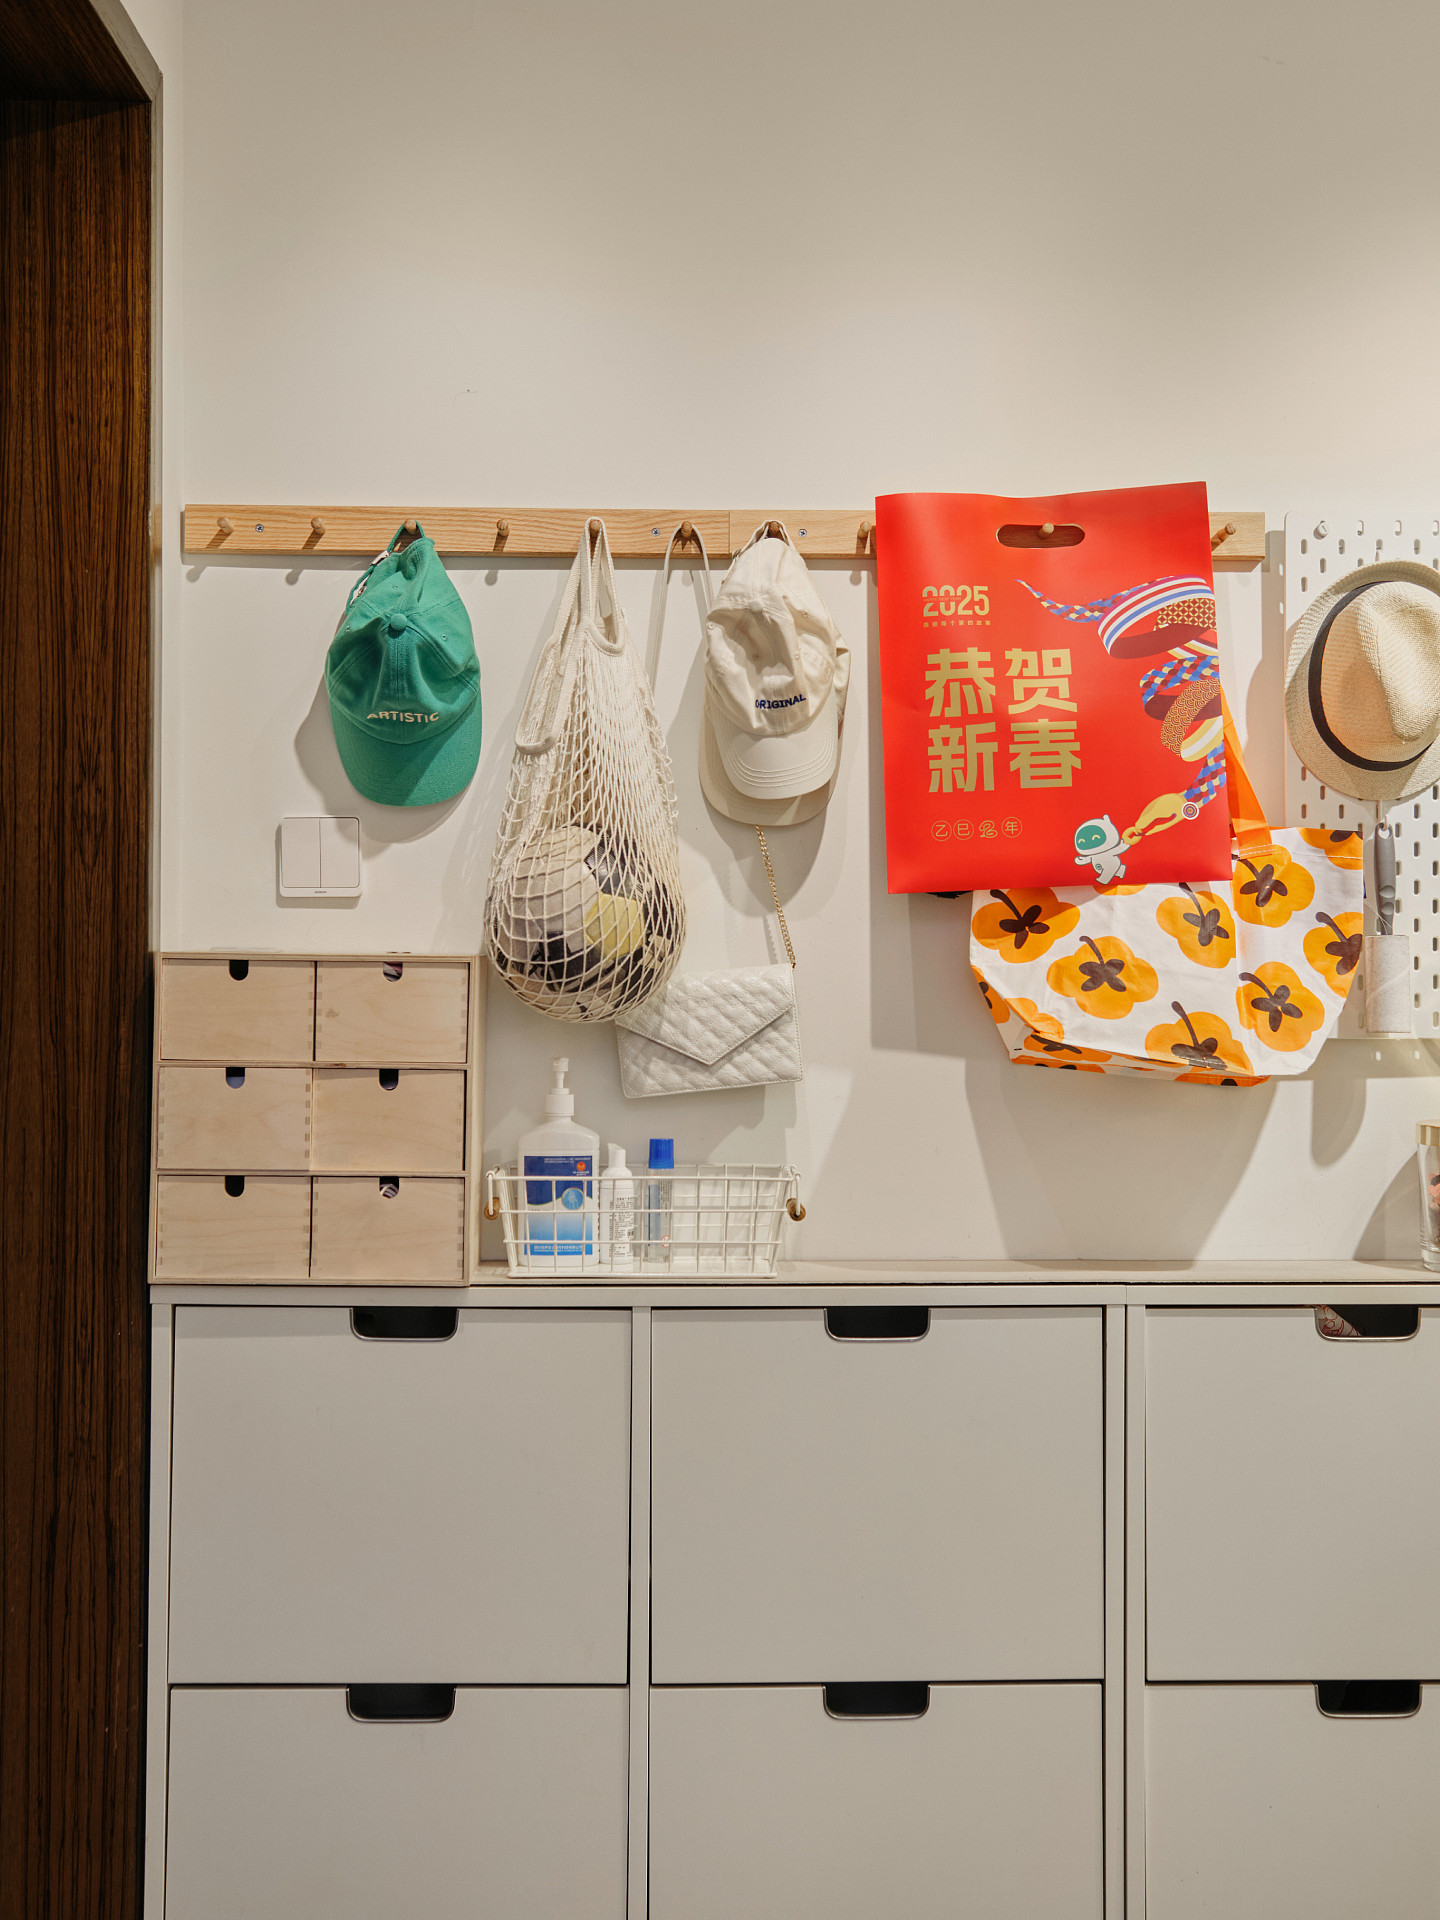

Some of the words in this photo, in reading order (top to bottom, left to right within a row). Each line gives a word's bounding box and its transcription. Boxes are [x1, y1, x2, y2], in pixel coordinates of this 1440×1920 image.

[922, 585, 990, 617] 2025
[925, 647, 1077, 717] 恭贺
[367, 711, 439, 723] ARTISTIC
[755, 694, 807, 709] ORIGINAL
[928, 718, 1081, 793] 新春
